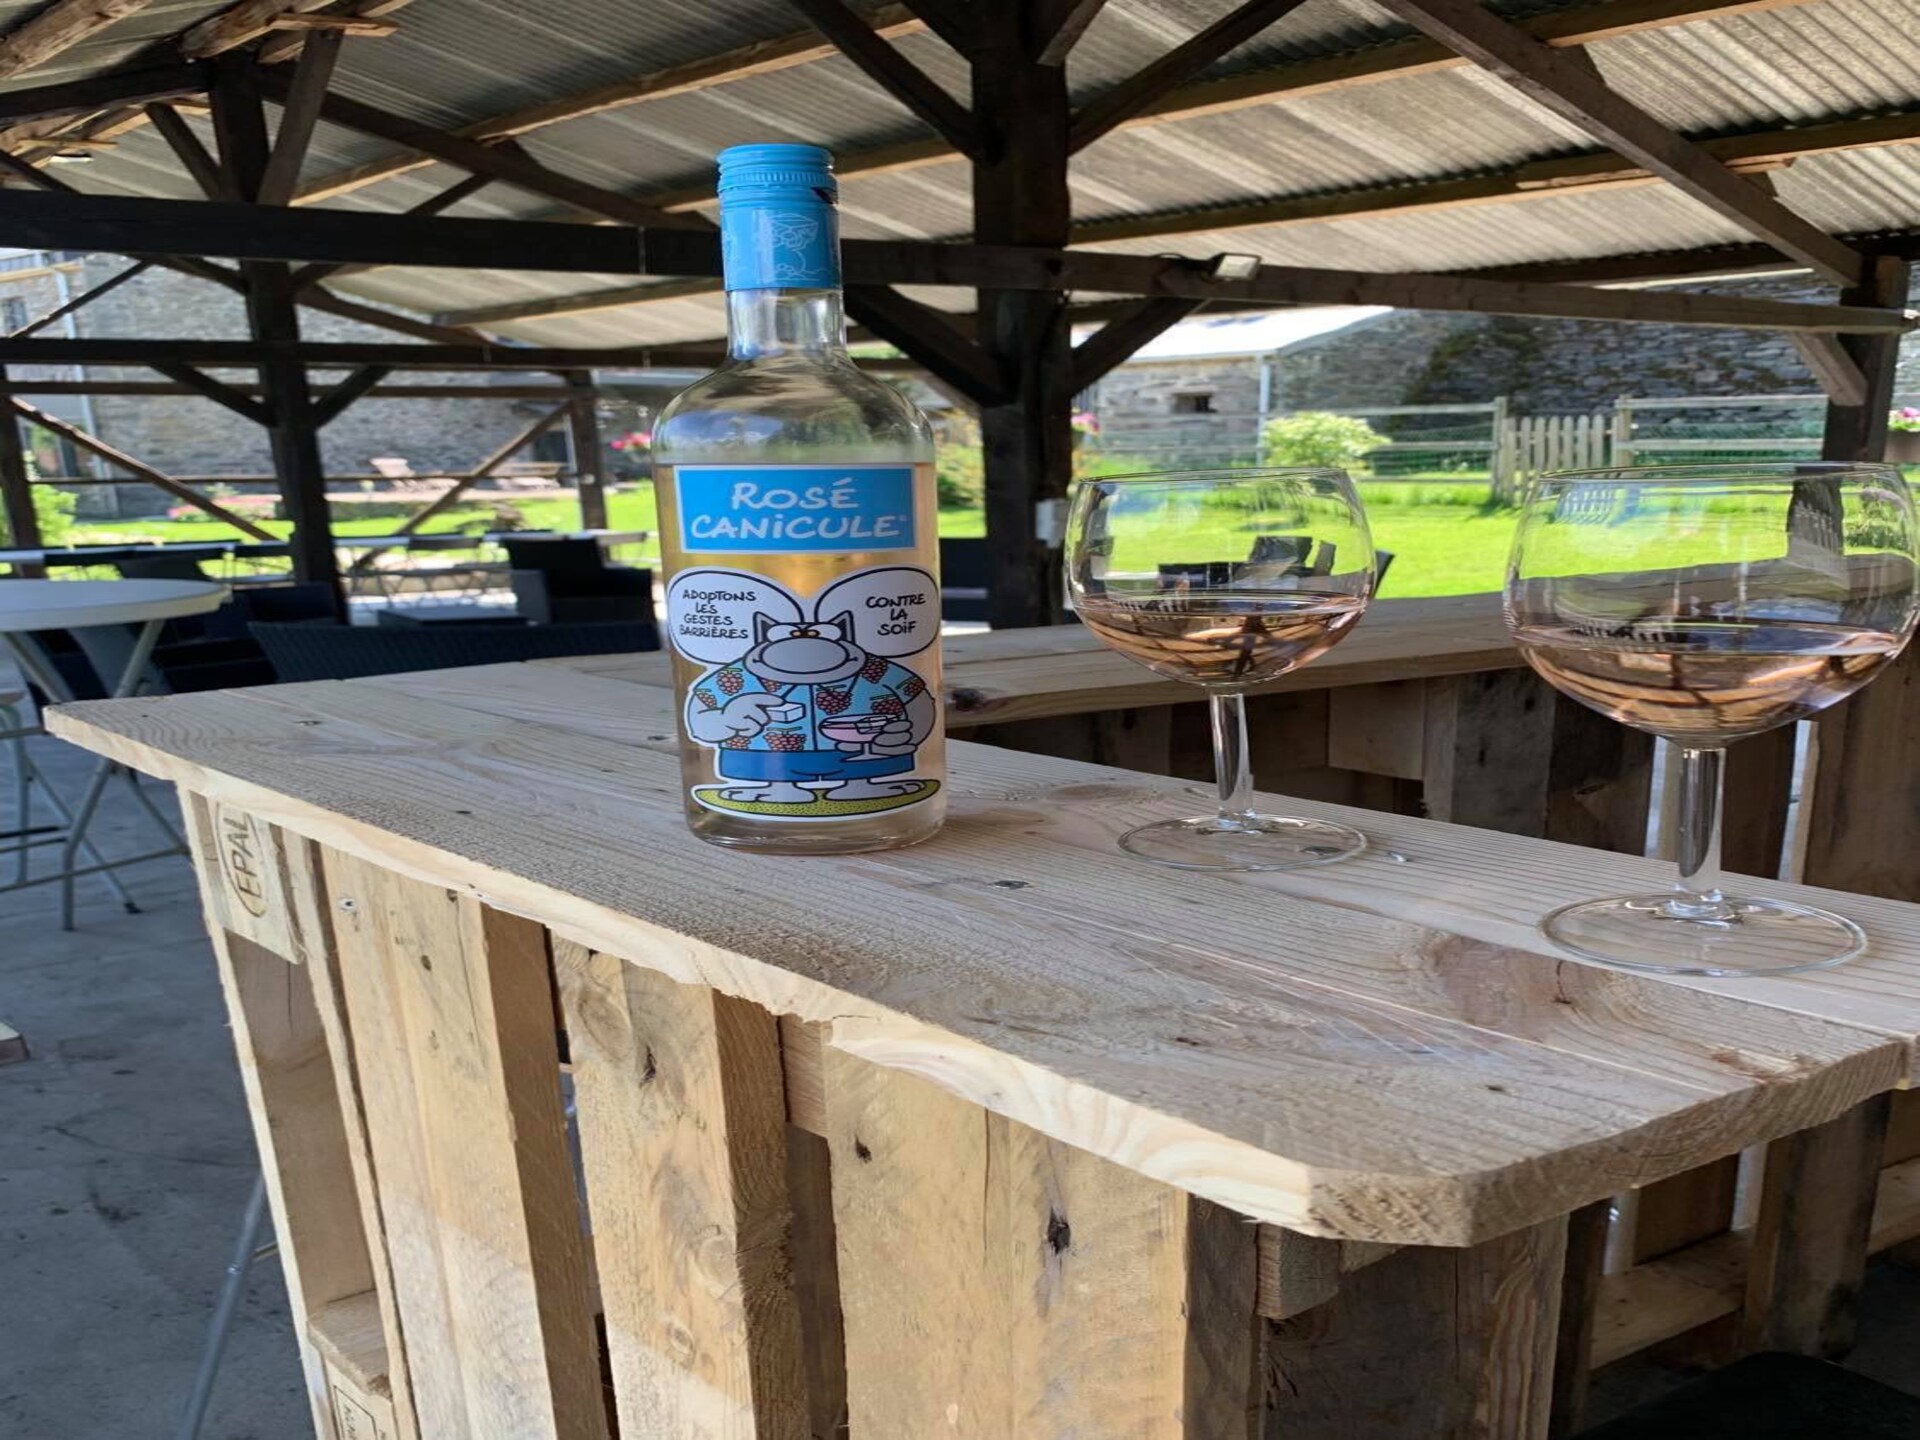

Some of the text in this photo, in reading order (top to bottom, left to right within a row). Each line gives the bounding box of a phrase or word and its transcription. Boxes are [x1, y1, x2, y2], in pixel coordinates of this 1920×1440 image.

[731, 477, 859, 511] ROSÉ
[682, 589, 757, 604] ADOPTONS
[865, 593, 926, 608] CONTRE
[695, 602, 718, 614] LES
[890, 608, 908, 621] LA
[684, 613, 733, 625] GESTES
[222, 811, 263, 899] EPAL
